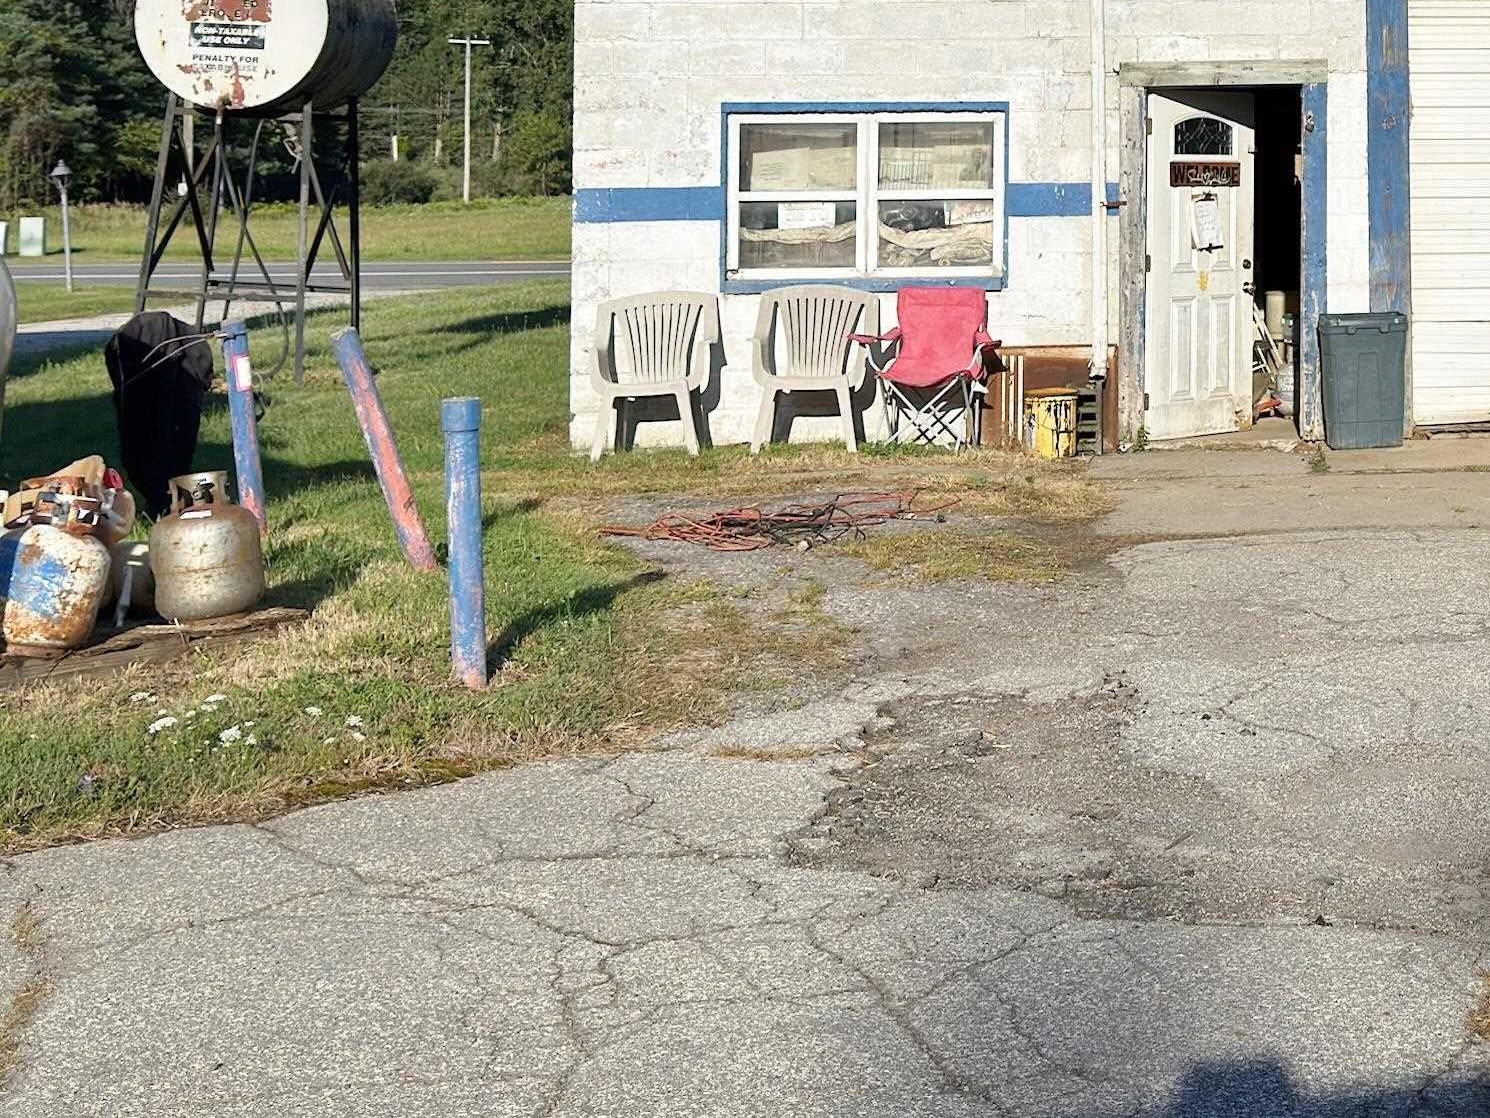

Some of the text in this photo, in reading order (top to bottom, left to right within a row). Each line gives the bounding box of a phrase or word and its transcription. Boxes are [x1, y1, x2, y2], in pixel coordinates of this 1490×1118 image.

[201, 35, 250, 45] USE ONLY
[192, 53, 259, 64] PENALTY FOR
